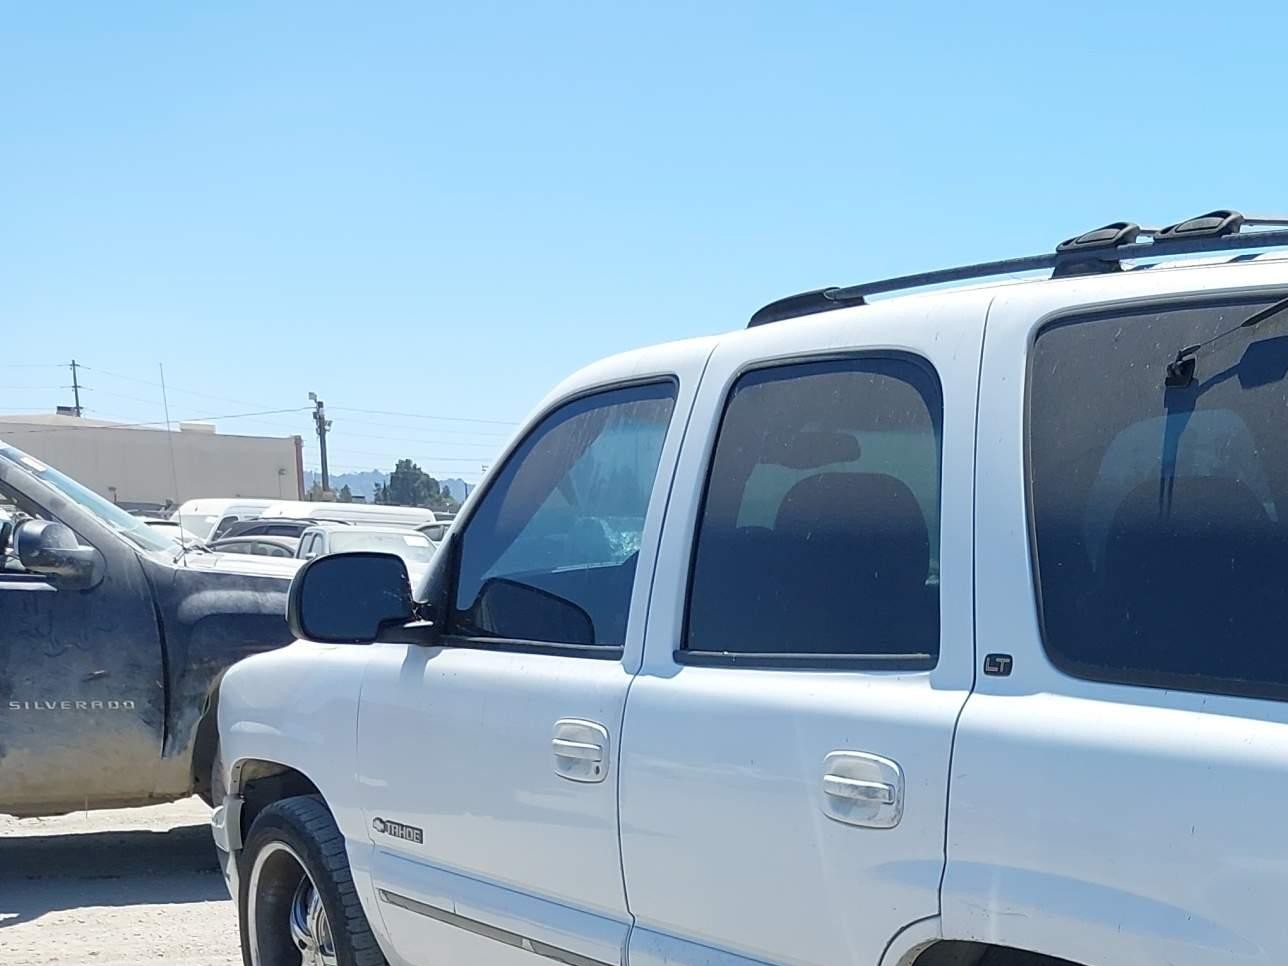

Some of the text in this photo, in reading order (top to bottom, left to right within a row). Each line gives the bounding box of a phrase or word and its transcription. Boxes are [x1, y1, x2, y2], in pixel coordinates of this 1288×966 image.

[985, 657, 1010, 672] LT
[9, 700, 135, 711] SILVERADO
[385, 821, 423, 844] TAHOE
